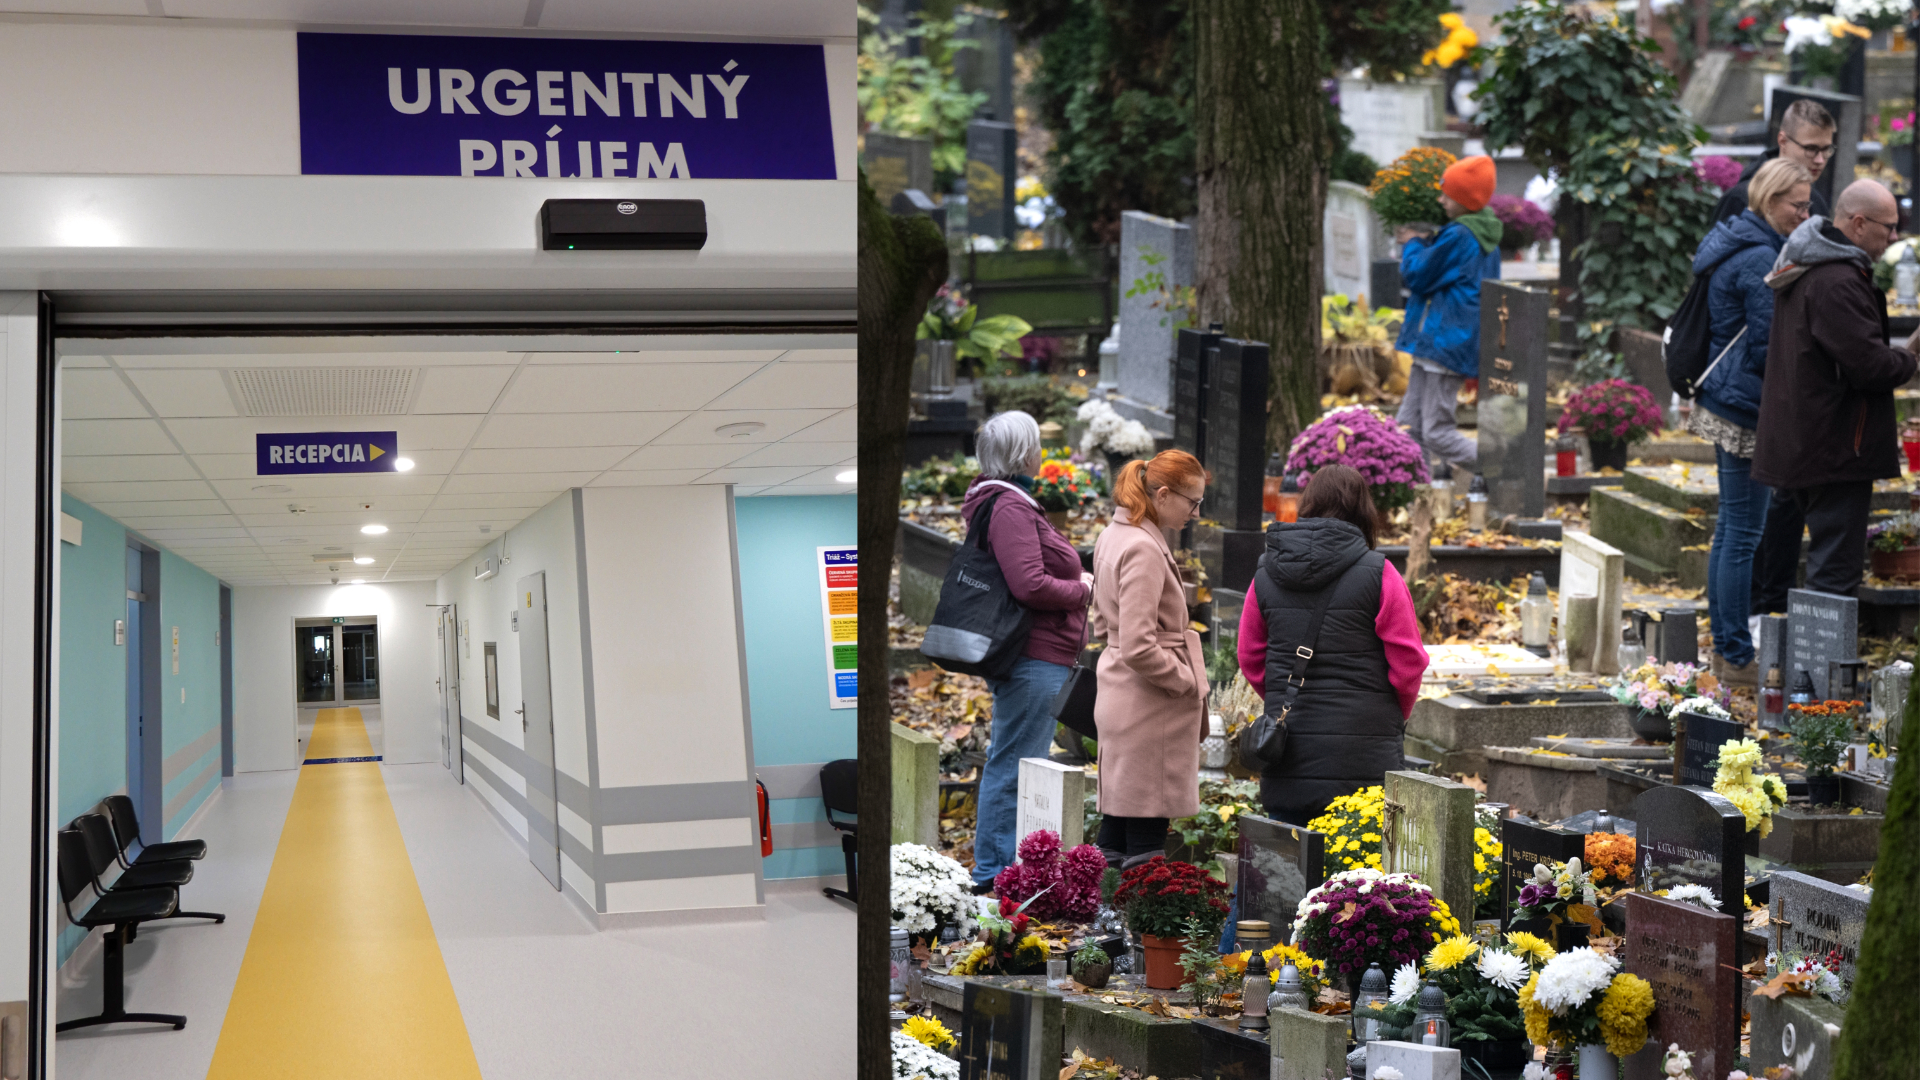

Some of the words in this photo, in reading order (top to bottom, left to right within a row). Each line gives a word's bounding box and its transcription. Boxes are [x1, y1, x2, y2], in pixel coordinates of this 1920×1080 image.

[388, 59, 750, 119] URGENTNÝ
[459, 124, 691, 178] PRÍJEM
[270, 444, 366, 464] RECEPCIA
[1522, 850, 1538, 863] PETER
